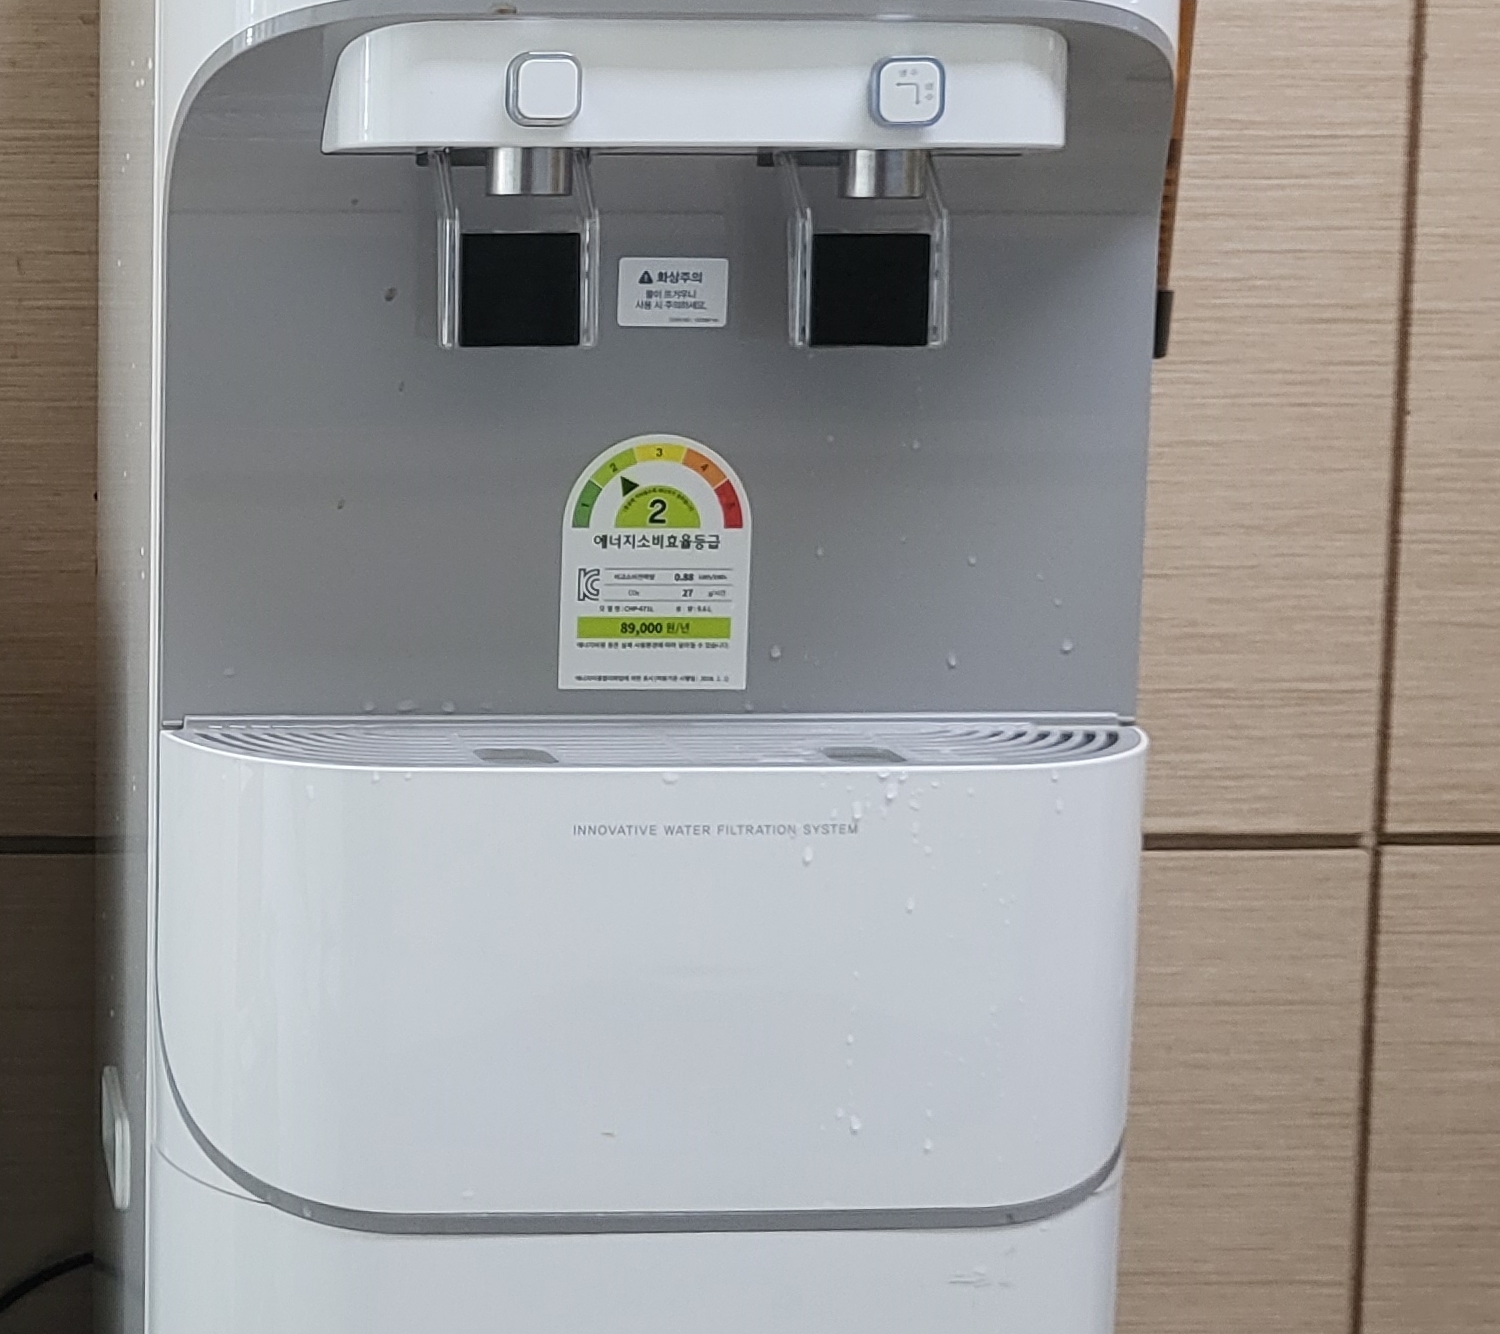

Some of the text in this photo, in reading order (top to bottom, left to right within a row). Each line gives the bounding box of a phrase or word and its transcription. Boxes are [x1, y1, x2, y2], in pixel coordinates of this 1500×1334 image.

[657, 271, 702, 284] 화상주의
[655, 448, 663, 457] 3
[609, 463, 618, 472] 2
[648, 498, 668, 524] 2
[594, 534, 720, 550] 에너지소비효율등급
[682, 589, 693, 597] 27
[620, 622, 690, 635] 89,000 원/년
[573, 823, 858, 836] INNOVATIVE WATER FILTRATION SYSTEM
